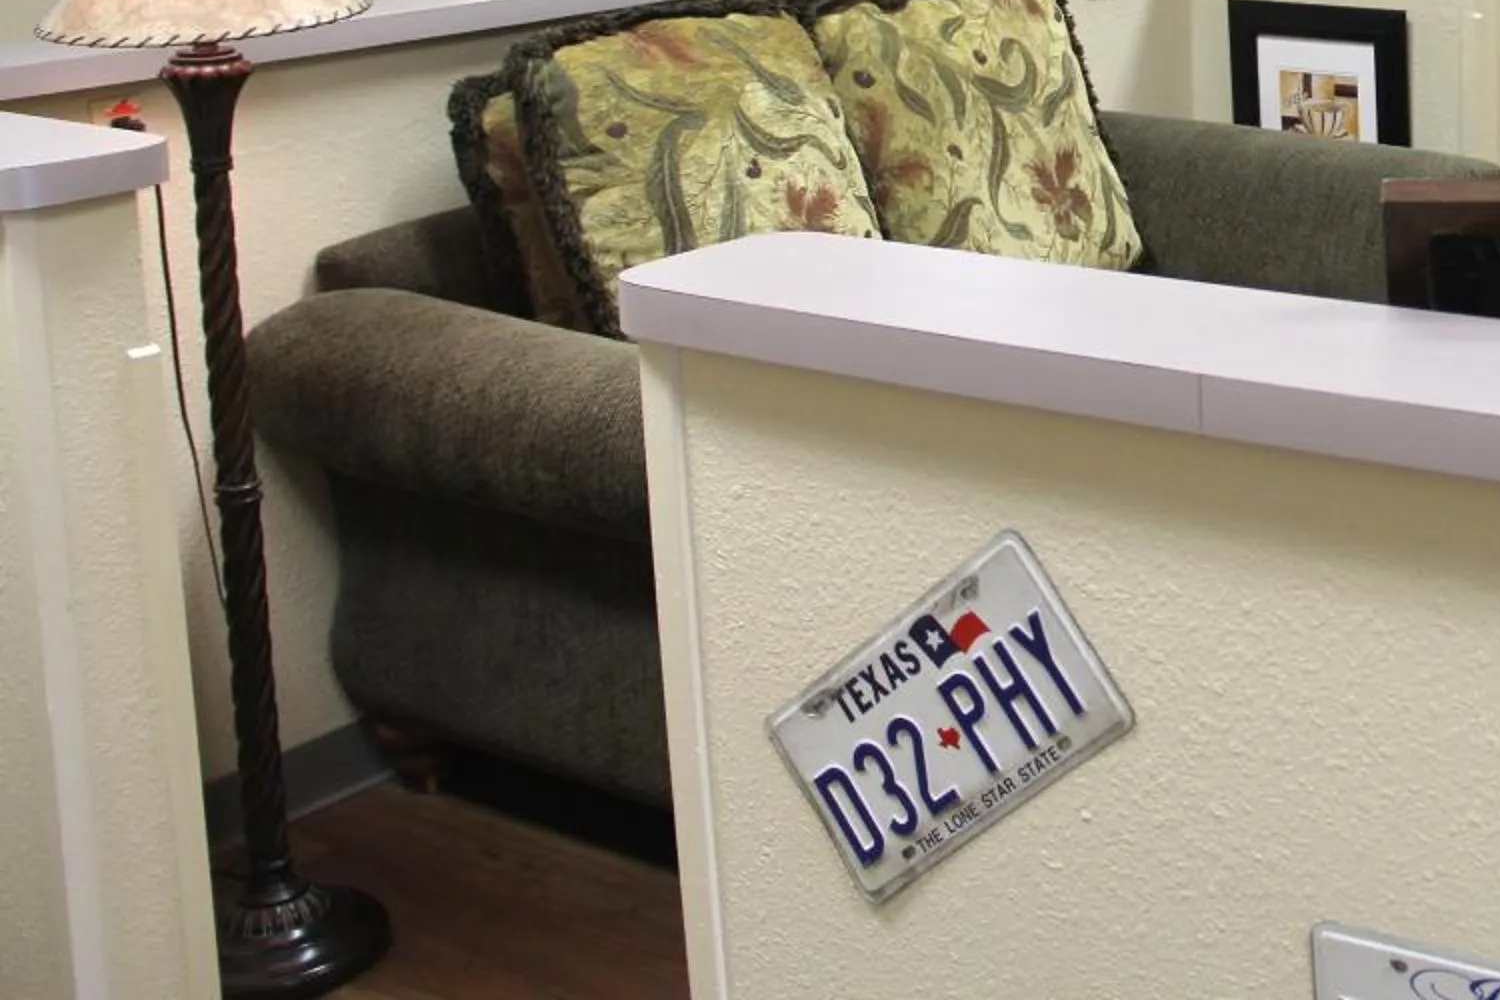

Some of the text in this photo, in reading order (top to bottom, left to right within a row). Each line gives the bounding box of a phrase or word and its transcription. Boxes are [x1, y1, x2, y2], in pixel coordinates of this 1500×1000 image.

[831, 639, 922, 724] TEXAS
[936, 609, 1085, 774] PHY
[916, 745, 1060, 853] THE LONE STAR STATE
